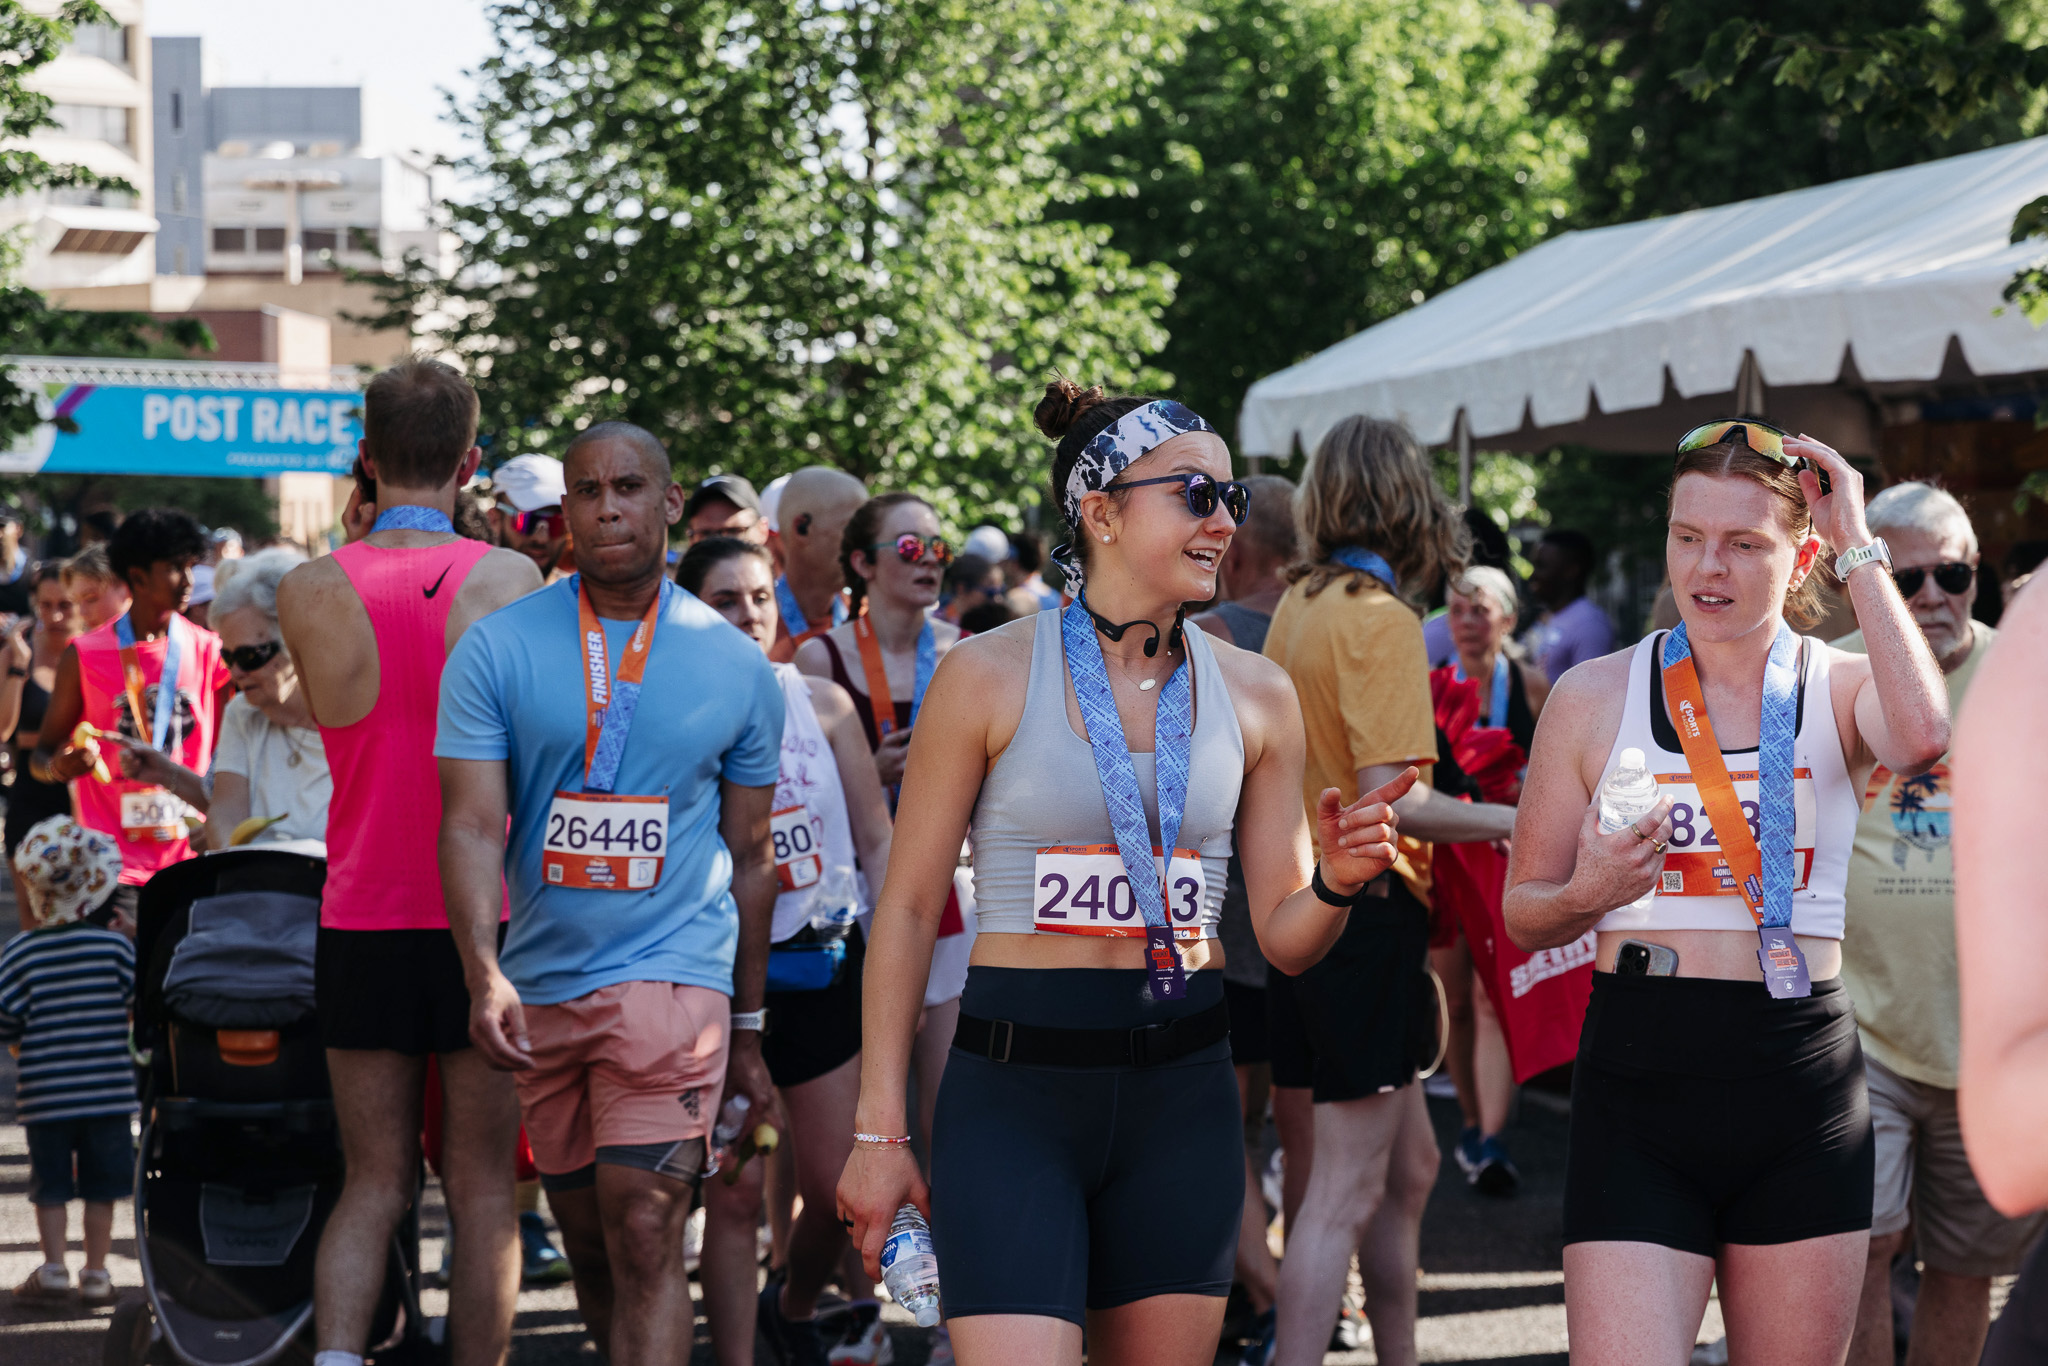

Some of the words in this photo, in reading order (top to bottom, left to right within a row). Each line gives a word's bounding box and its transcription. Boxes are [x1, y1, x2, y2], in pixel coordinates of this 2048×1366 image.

[143, 394, 244, 442] POST
[252, 397, 356, 446] RACE
[587, 630, 608, 706] FINISHER
[1686, 709, 1701, 738] SPORTS
[548, 813, 662, 853] 26446
[772, 824, 812, 859] 80
[1099, 846, 1119, 854] APRIL
[1038, 873, 1199, 922] 2403
[1181, 929, 1187, 938] C
